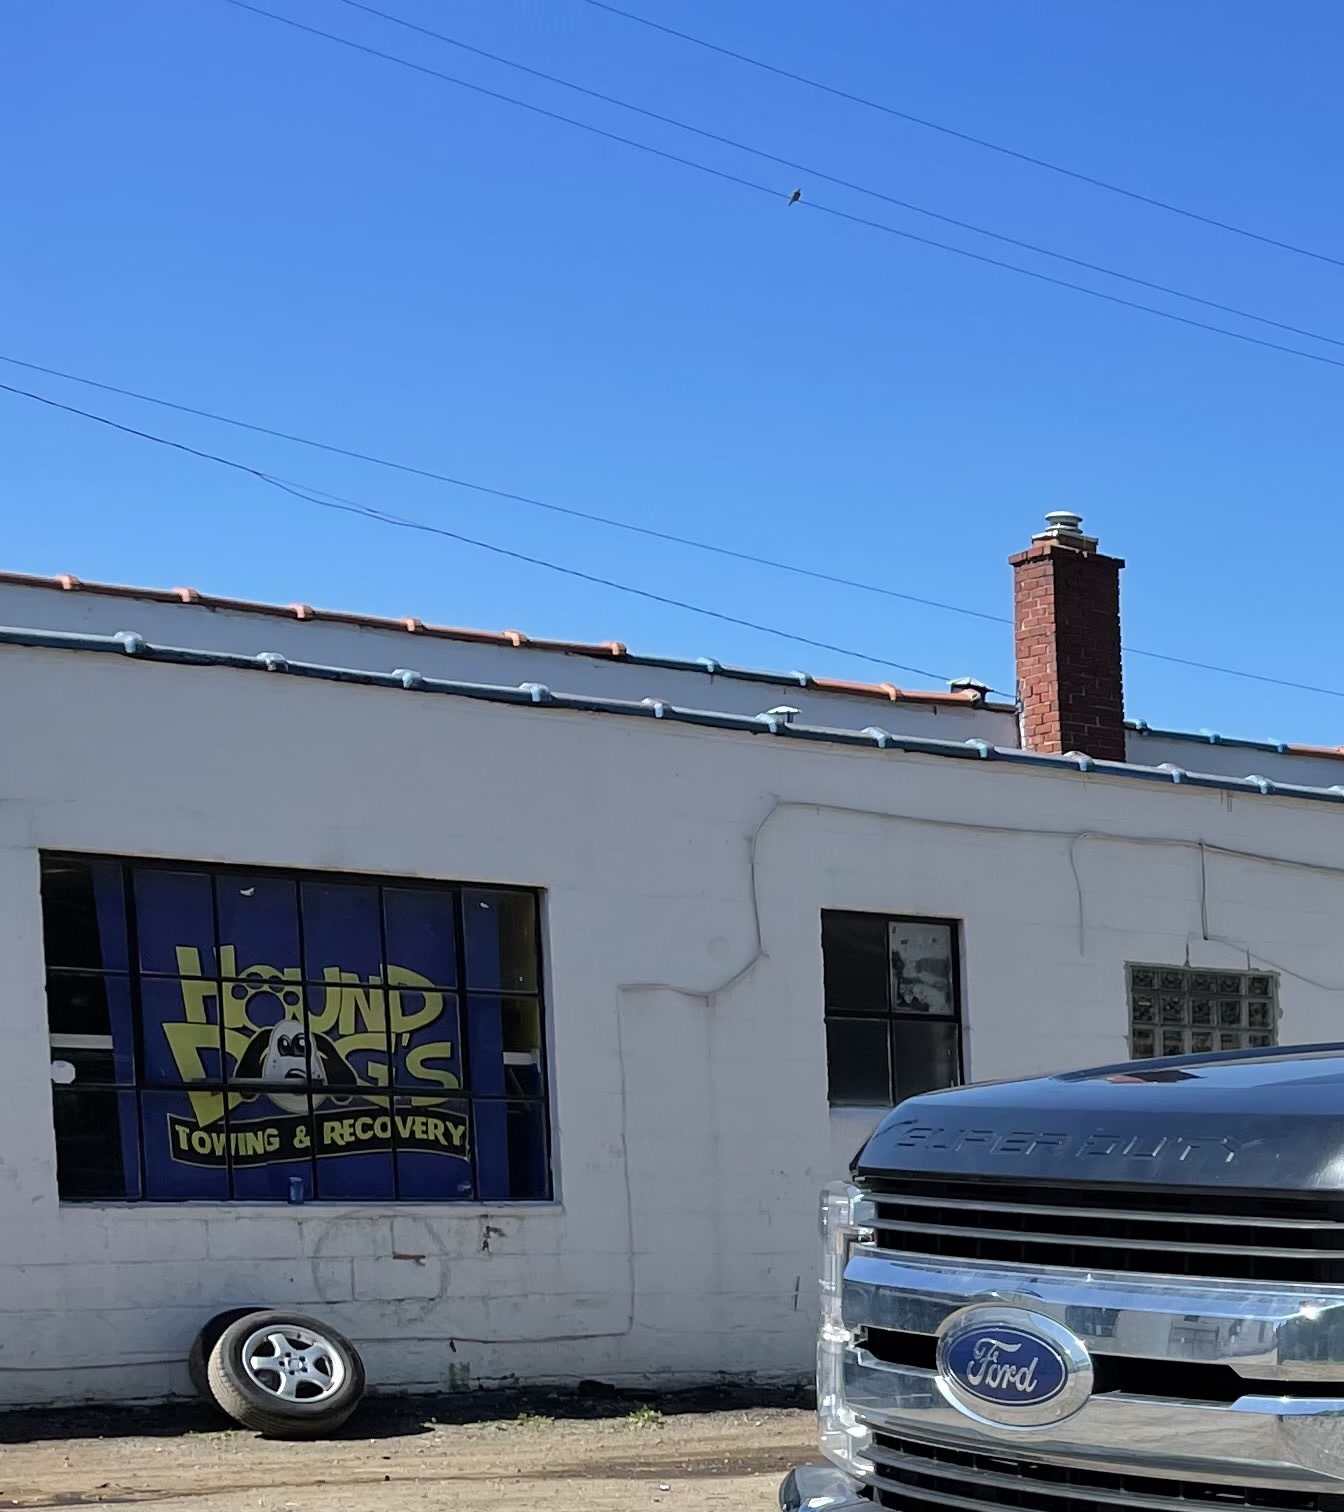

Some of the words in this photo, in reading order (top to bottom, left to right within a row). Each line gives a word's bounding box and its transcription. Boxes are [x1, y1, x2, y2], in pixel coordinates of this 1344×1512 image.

[176, 945, 444, 1034] HOUND
[175, 1124, 280, 1156] TOWING
[293, 1125, 312, 1149] &
[323, 1115, 466, 1147] RECOVERY
[897, 1126, 1071, 1158] SUPER
[1075, 1128, 1264, 1163] DUTY
[966, 1337, 1040, 1393] Ford
